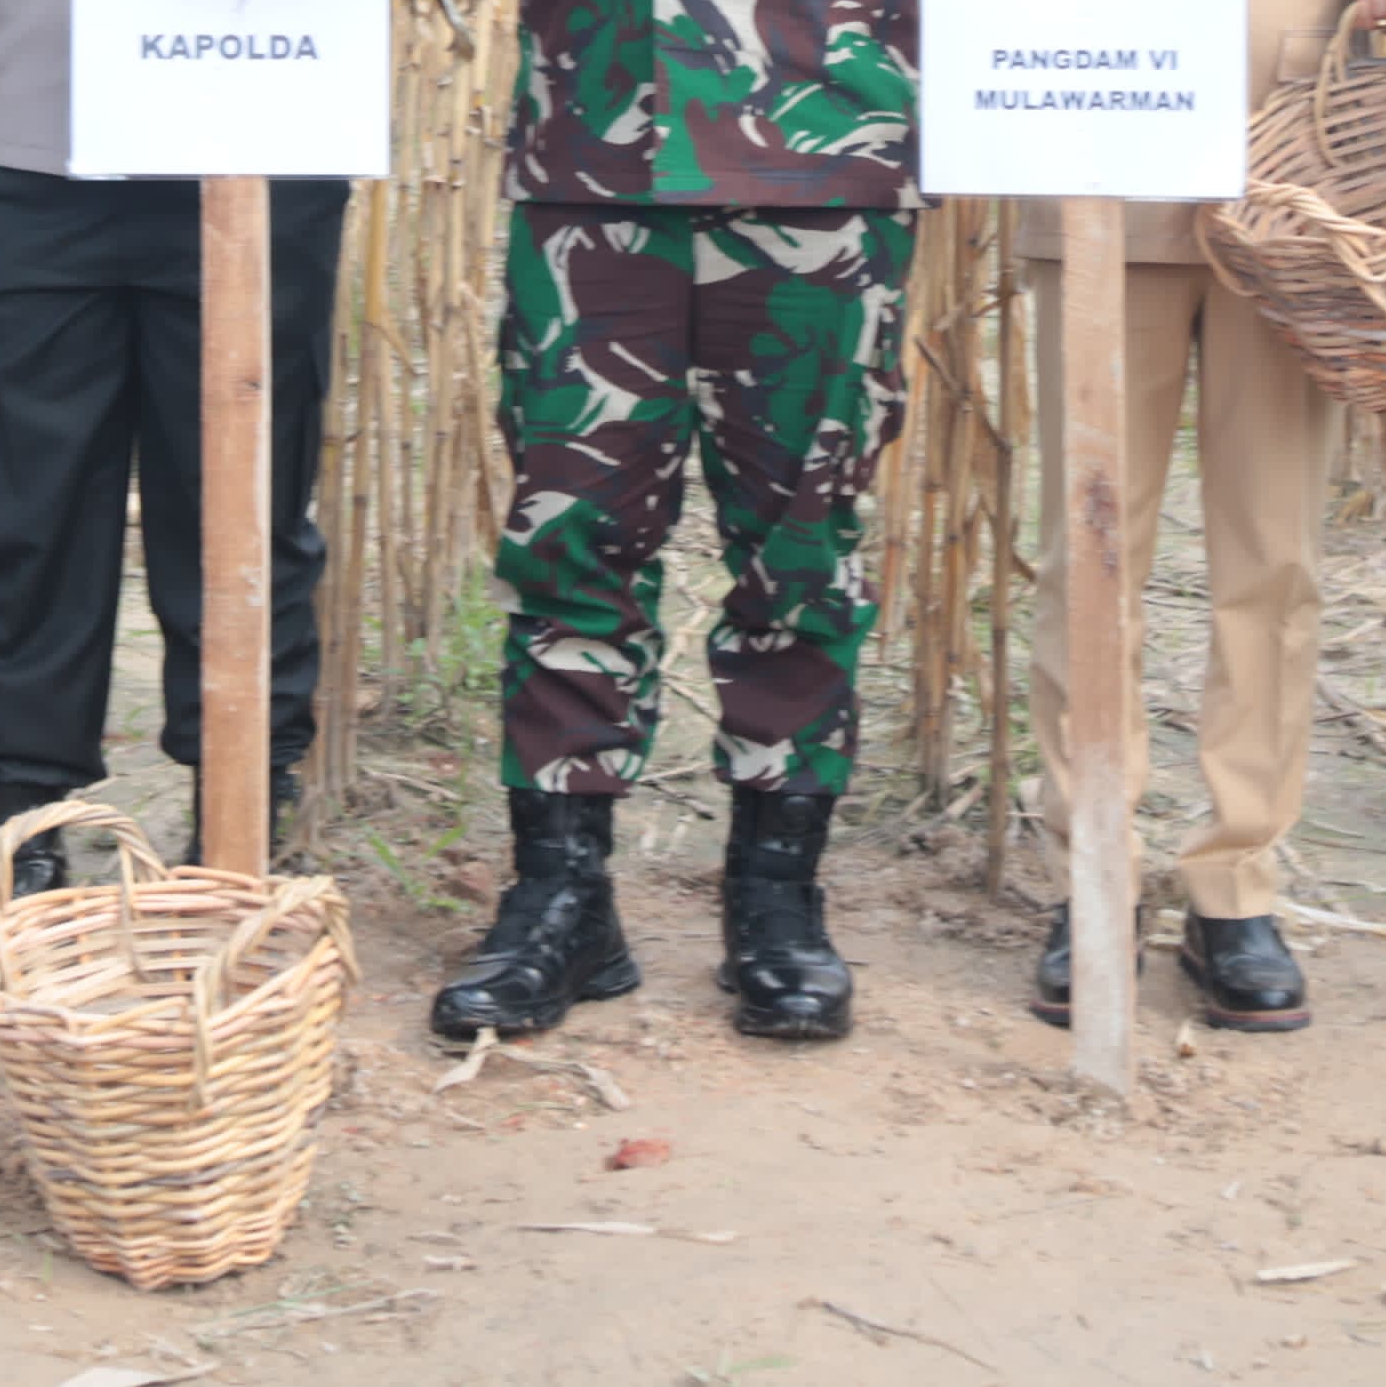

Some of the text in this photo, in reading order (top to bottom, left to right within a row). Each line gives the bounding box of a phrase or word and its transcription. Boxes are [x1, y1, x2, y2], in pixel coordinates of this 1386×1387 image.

[140, 34, 319, 61] KAPOLDA
[992, 50, 1179, 71] PANGDAM VI
[975, 90, 1196, 112] MULAWARMAN
